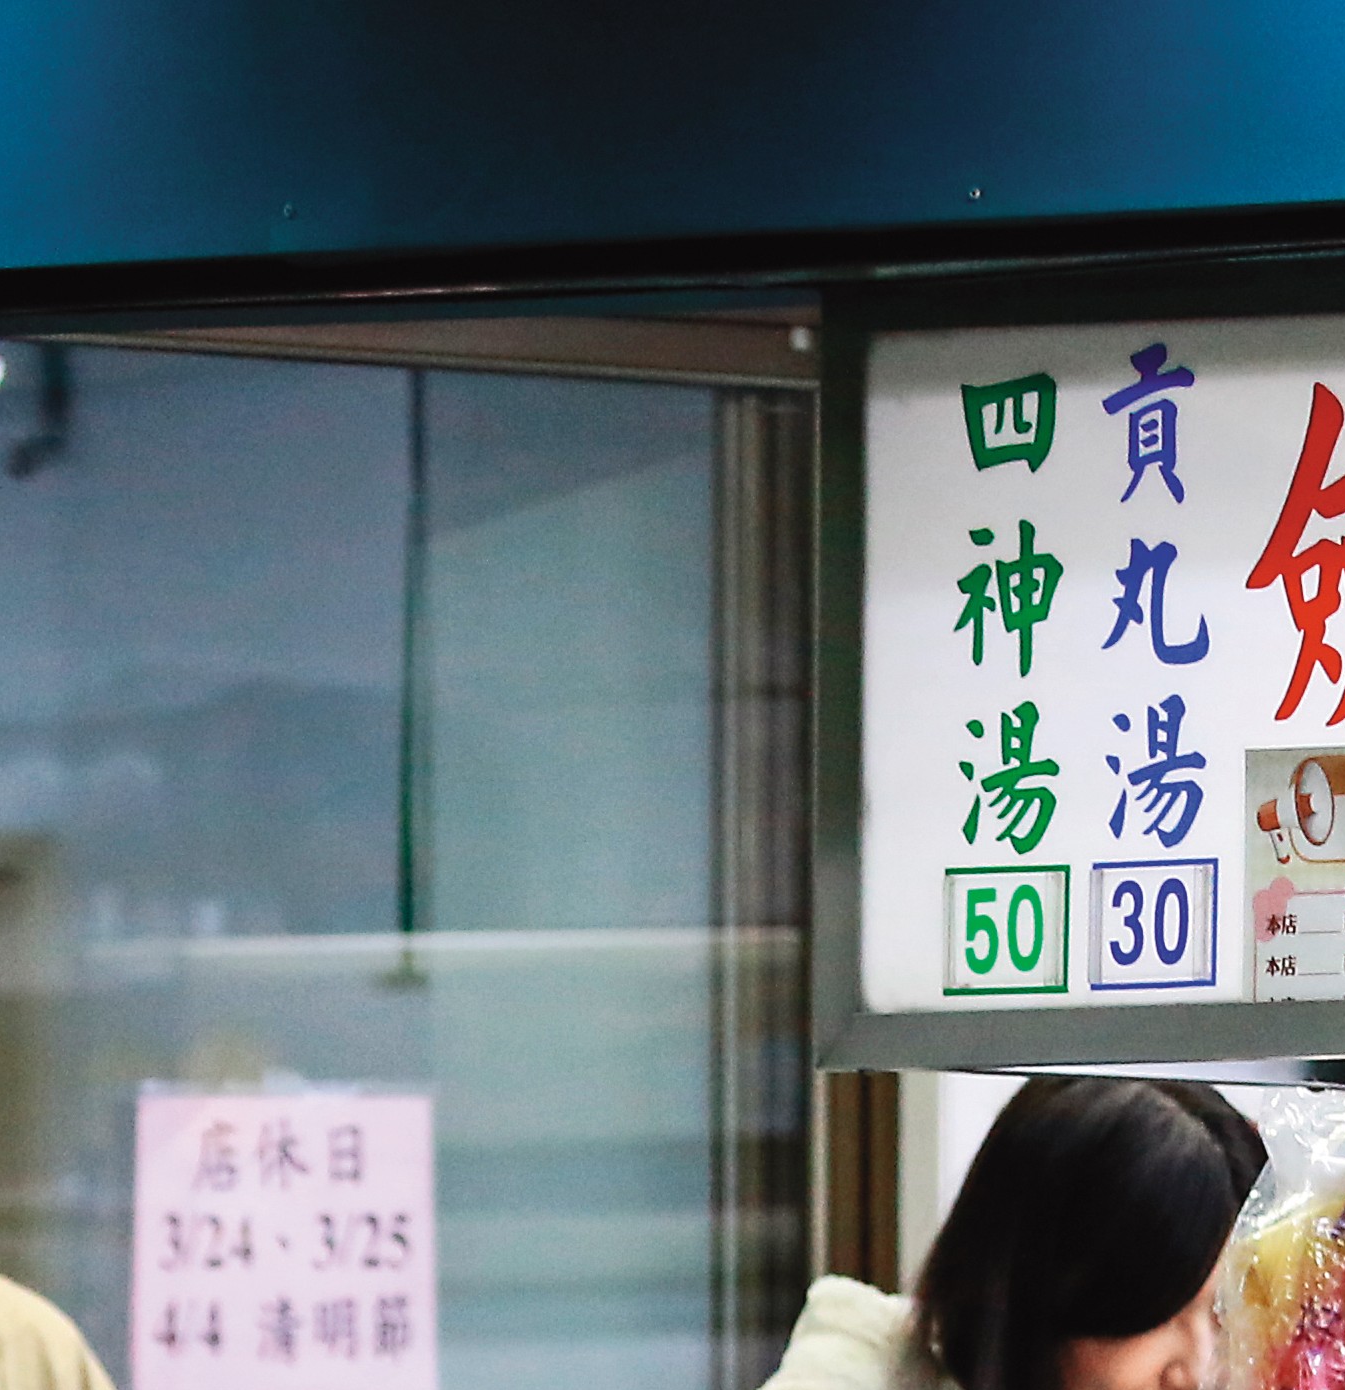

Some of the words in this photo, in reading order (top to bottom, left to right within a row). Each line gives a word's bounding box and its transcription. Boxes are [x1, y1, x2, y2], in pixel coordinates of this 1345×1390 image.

[954, 372, 1063, 855] 四神湯
[1102, 342, 1209, 850] 貢丸湯
[964, 883, 1045, 976] 50
[1110, 877, 1190, 967] 30
[1265, 955, 1297, 977] 本店
[1266, 914, 1298, 935] 本店
